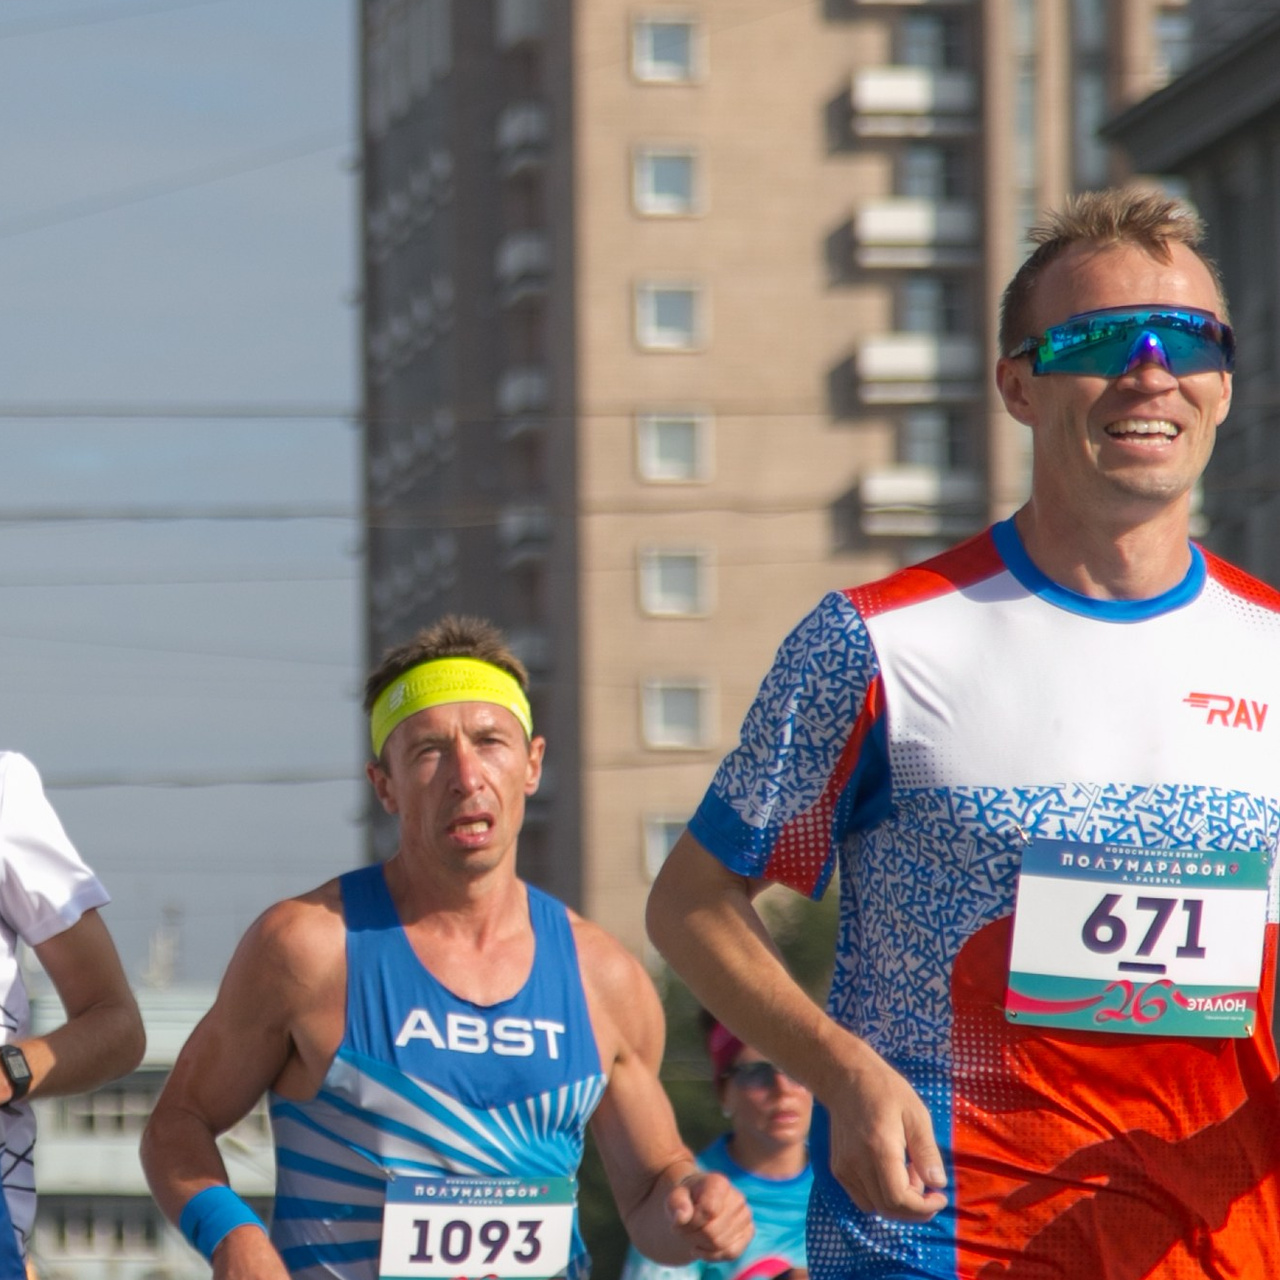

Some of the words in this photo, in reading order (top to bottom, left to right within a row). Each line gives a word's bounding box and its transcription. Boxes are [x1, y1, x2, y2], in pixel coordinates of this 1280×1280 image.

[1183, 692, 1268, 732] RAY
[1061, 852, 1226, 877] ПОЛУМАРАФОН
[1081, 893, 1207, 959] 671
[1186, 998, 1247, 1012] ЭТАЛОН
[395, 1009, 565, 1060] ABST
[409, 1220, 544, 1265] 1093
